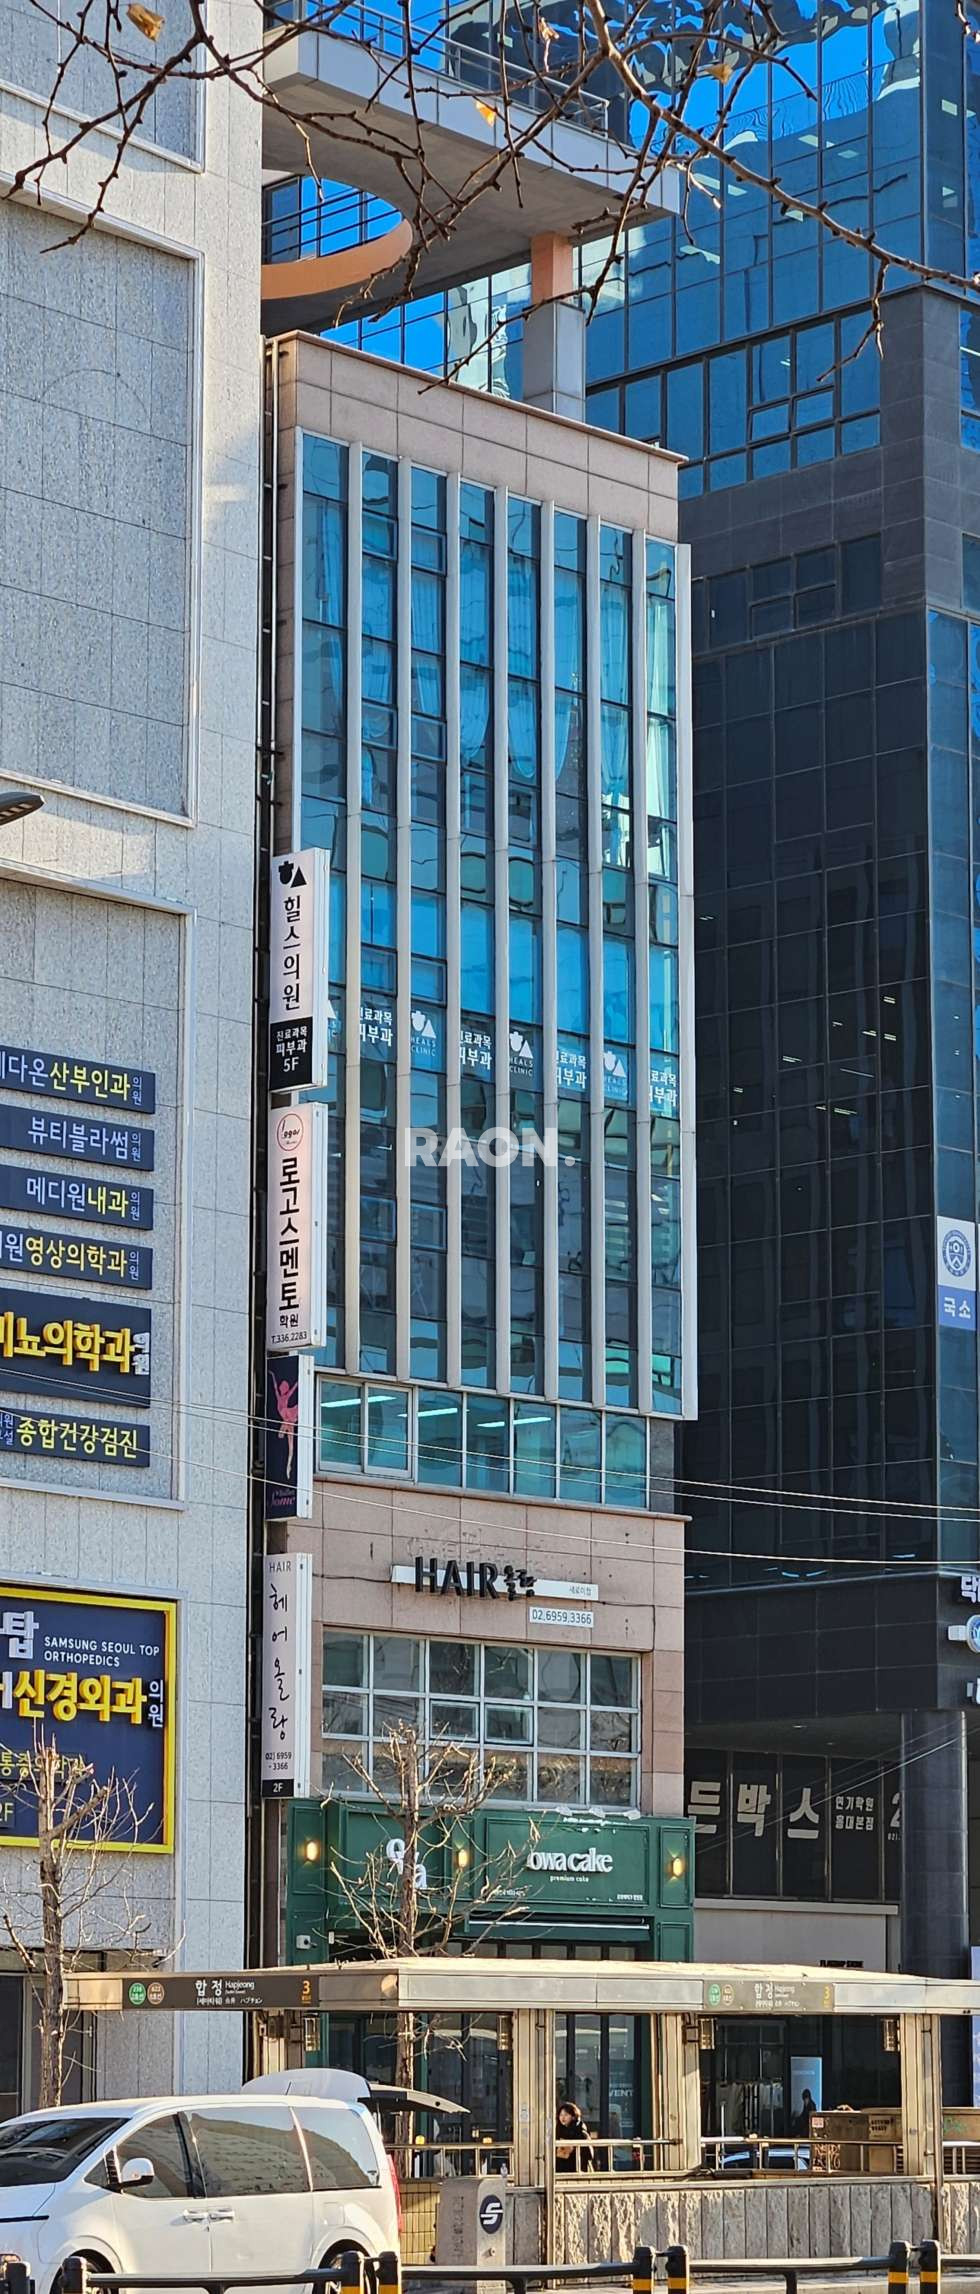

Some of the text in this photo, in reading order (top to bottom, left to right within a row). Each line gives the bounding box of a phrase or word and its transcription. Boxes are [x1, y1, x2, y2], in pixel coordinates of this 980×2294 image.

[283, 895, 301, 1010] 힐스의원
[276, 1025, 307, 1040] 진료과목
[276, 1039, 307, 1057] 피부과
[283, 1057, 299, 1073] 5F
[650, 1069, 677, 1087] 료과목
[28, 1116, 129, 1160] 뷰티블라썸
[26, 1176, 129, 1218] 메디원내과
[279, 1156, 300, 1312] 로고스멘토
[0, 1230, 128, 1277] 원영상의학과
[279, 1313, 299, 1329] 학원
[17, 1416, 138, 1459] 종합건강검진
[269, 1560, 292, 1573] HAIR
[415, 1556, 500, 1599] HAIR
[531, 1608, 592, 1625] 02.6959.3366
[44, 1636, 161, 1657] SAMSUNG SEOUL TOP
[44, 1650, 121, 1668] ORTHOPEDICS
[148, 1680, 165, 1728] 의원
[273, 1782, 284, 1793] 2F
[835, 1795, 874, 1813] 연기학원
[835, 1814, 874, 1832] 홍대본점
[567, 1847, 614, 1873] cake
[195, 1979, 222, 1997] 합정
[225, 1981, 255, 1990] Hapjeong
[303, 1980, 310, 1995] 3
[823, 1985, 831, 2000] 3
